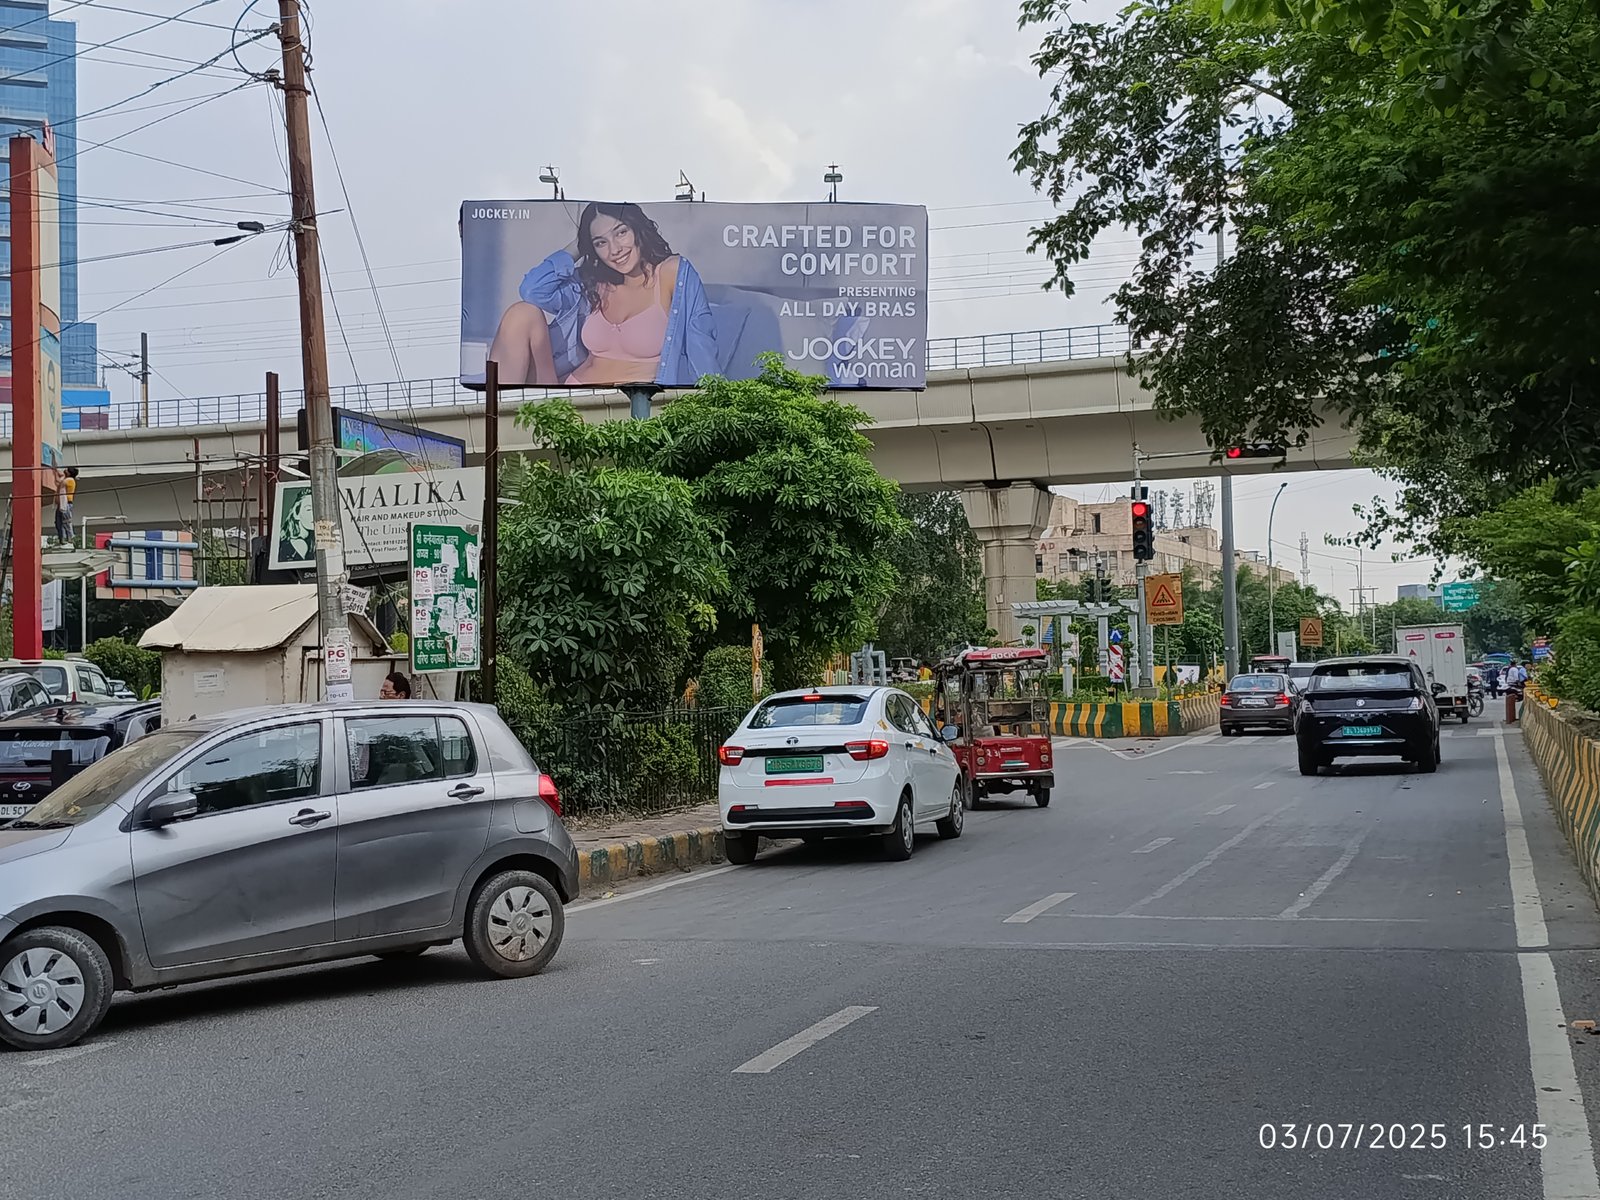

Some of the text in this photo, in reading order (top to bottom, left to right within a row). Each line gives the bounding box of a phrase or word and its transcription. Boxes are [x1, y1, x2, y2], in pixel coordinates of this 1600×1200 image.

[471, 208, 530, 219] JOCKEY.IN
[722, 224, 916, 248] CRAFTED FOR
[781, 252, 916, 276] COMFORT
[838, 286, 916, 297] PRESENTING
[779, 301, 916, 317] ALL DAY BRAS
[787, 337, 916, 361] JOCKEY
[832, 361, 916, 379] woman
[344, 480, 467, 510] MALIKA
[351, 508, 459, 523] HAIR AND MAKEUP STUDIO
[358, 525, 379, 536] The
[415, 570, 428, 579] PG
[433, 565, 448, 574] PG
[415, 609, 427, 617] PG
[459, 623, 473, 631] PG
[327, 649, 346, 659] PG
[990, 651, 1020, 660] ROCKY
